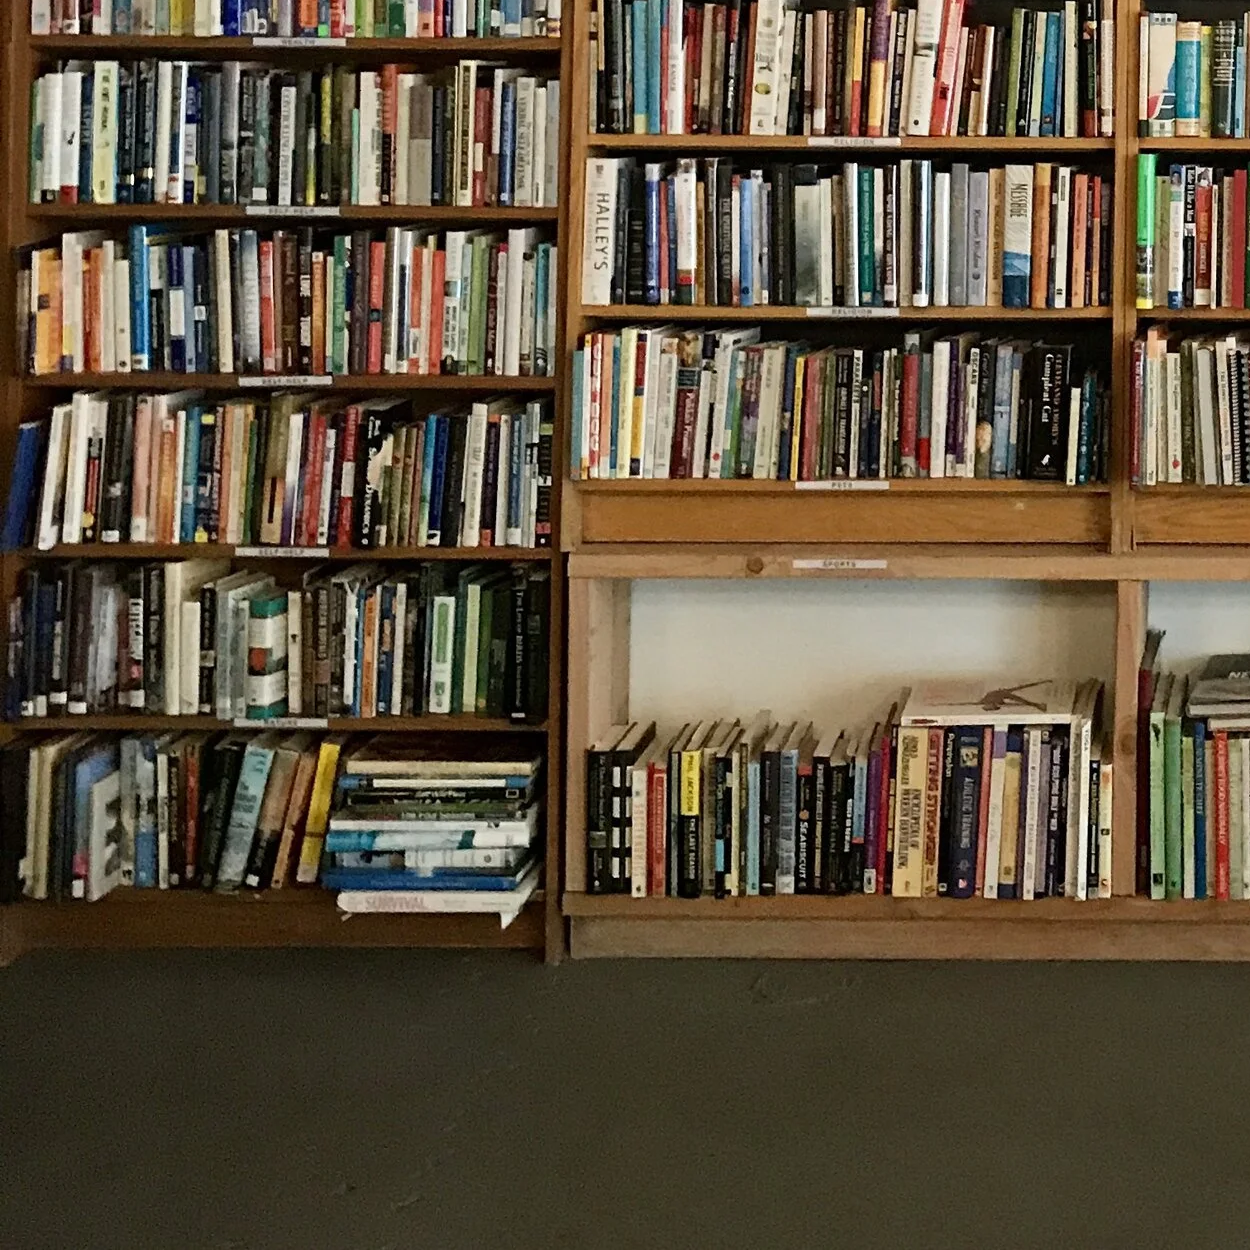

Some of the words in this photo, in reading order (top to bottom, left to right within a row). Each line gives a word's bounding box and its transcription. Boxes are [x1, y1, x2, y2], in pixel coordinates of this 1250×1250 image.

[593, 193, 611, 271] HALLEY'S
[853, 356, 861, 405] PARAKEETS
[1041, 353, 1055, 402] Compleat
[1055, 353, 1064, 405] CLEVELAND
[1041, 406, 1053, 423] Cat
[361, 484, 376, 534] DYNAMICS
[515, 635, 524, 663] BIRDS
[686, 754, 695, 773] PHIL
[929, 733, 942, 792] GETTING
[686, 776, 695, 813] JACKSON
[962, 777, 976, 812] ATHLETIC
[688, 818, 696, 831] THE
[688, 833, 696, 850] LAST
[927, 793, 939, 866] STRONGER
[959, 813, 973, 849] TRAINING
[687, 852, 696, 880] SEASON
[798, 821, 809, 879] SEABISCUIT
[364, 894, 430, 911] SURVIVAL
